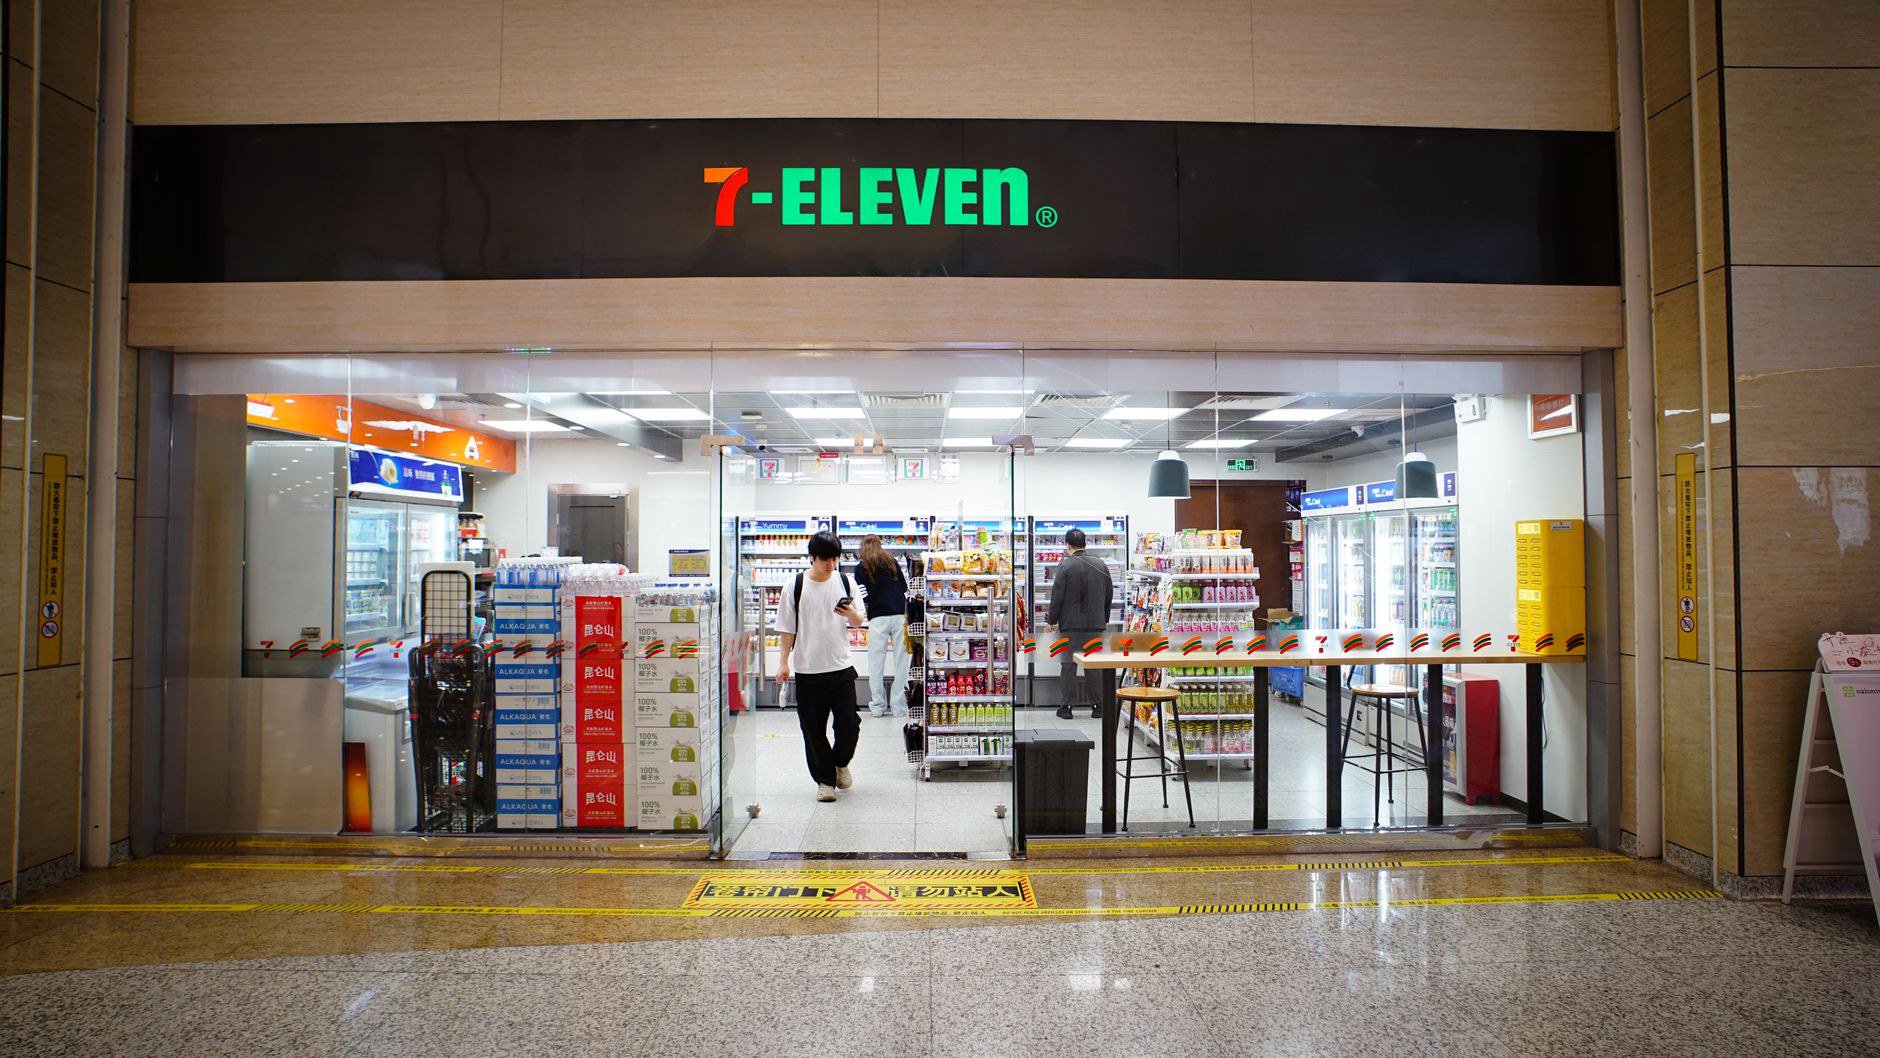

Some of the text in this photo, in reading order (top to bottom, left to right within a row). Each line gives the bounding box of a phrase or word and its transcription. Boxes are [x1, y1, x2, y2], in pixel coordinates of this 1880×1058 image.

[762, 522, 788, 530] Yummy
[584, 624, 615, 637] 昆仑山
[584, 666, 615, 679] 昆仑山
[638, 663, 657, 671] 100%
[584, 708, 615, 721] 昆仑山
[585, 750, 616, 763] 昆仑山
[585, 792, 616, 805] 昆仑山
